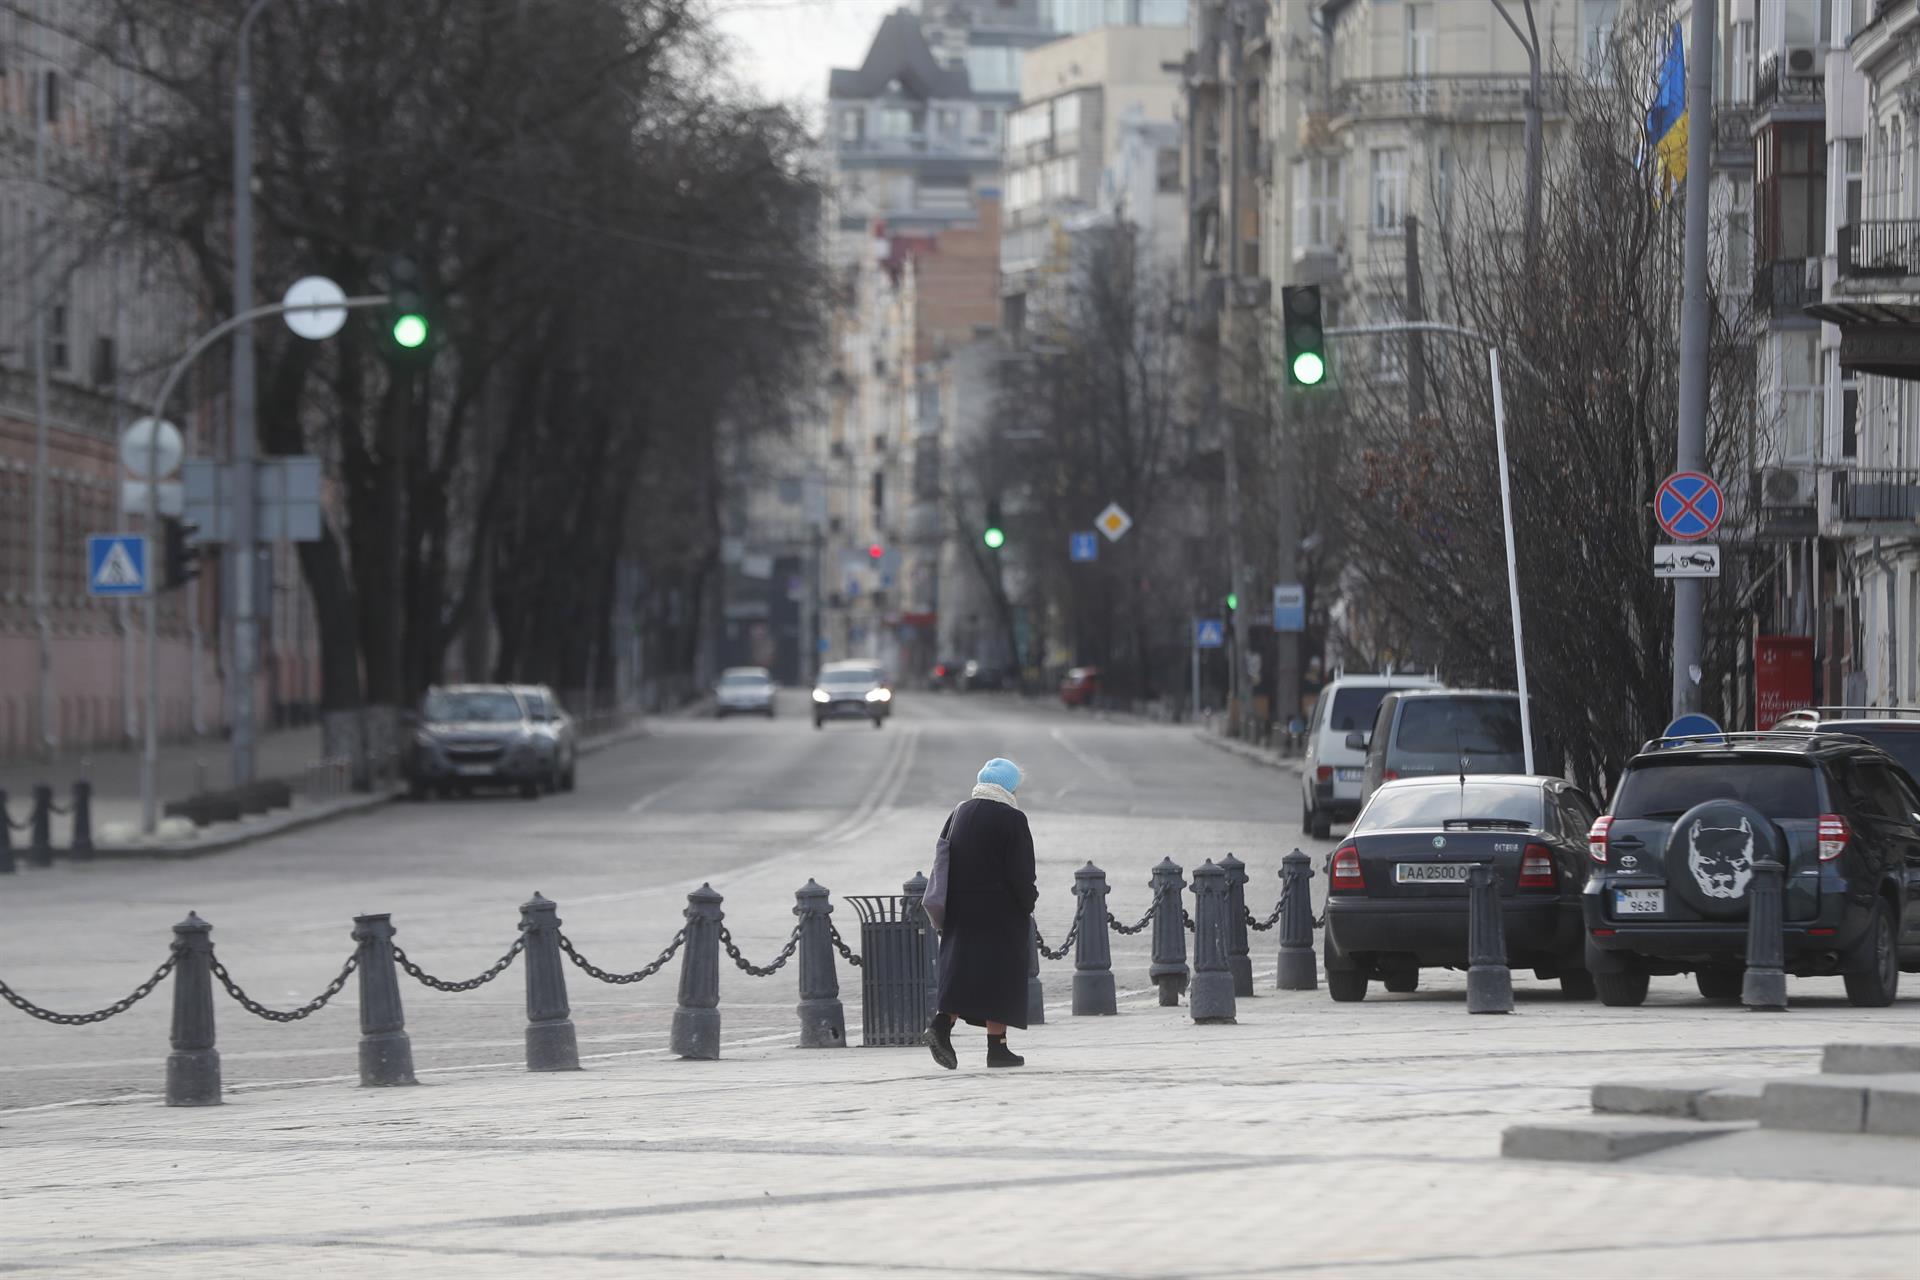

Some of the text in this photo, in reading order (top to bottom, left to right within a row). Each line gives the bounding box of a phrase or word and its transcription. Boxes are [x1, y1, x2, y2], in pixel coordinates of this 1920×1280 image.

[1407, 866, 1424, 879] AA
[1427, 866, 1456, 879] 2500
[1631, 901, 1658, 912] 9628
